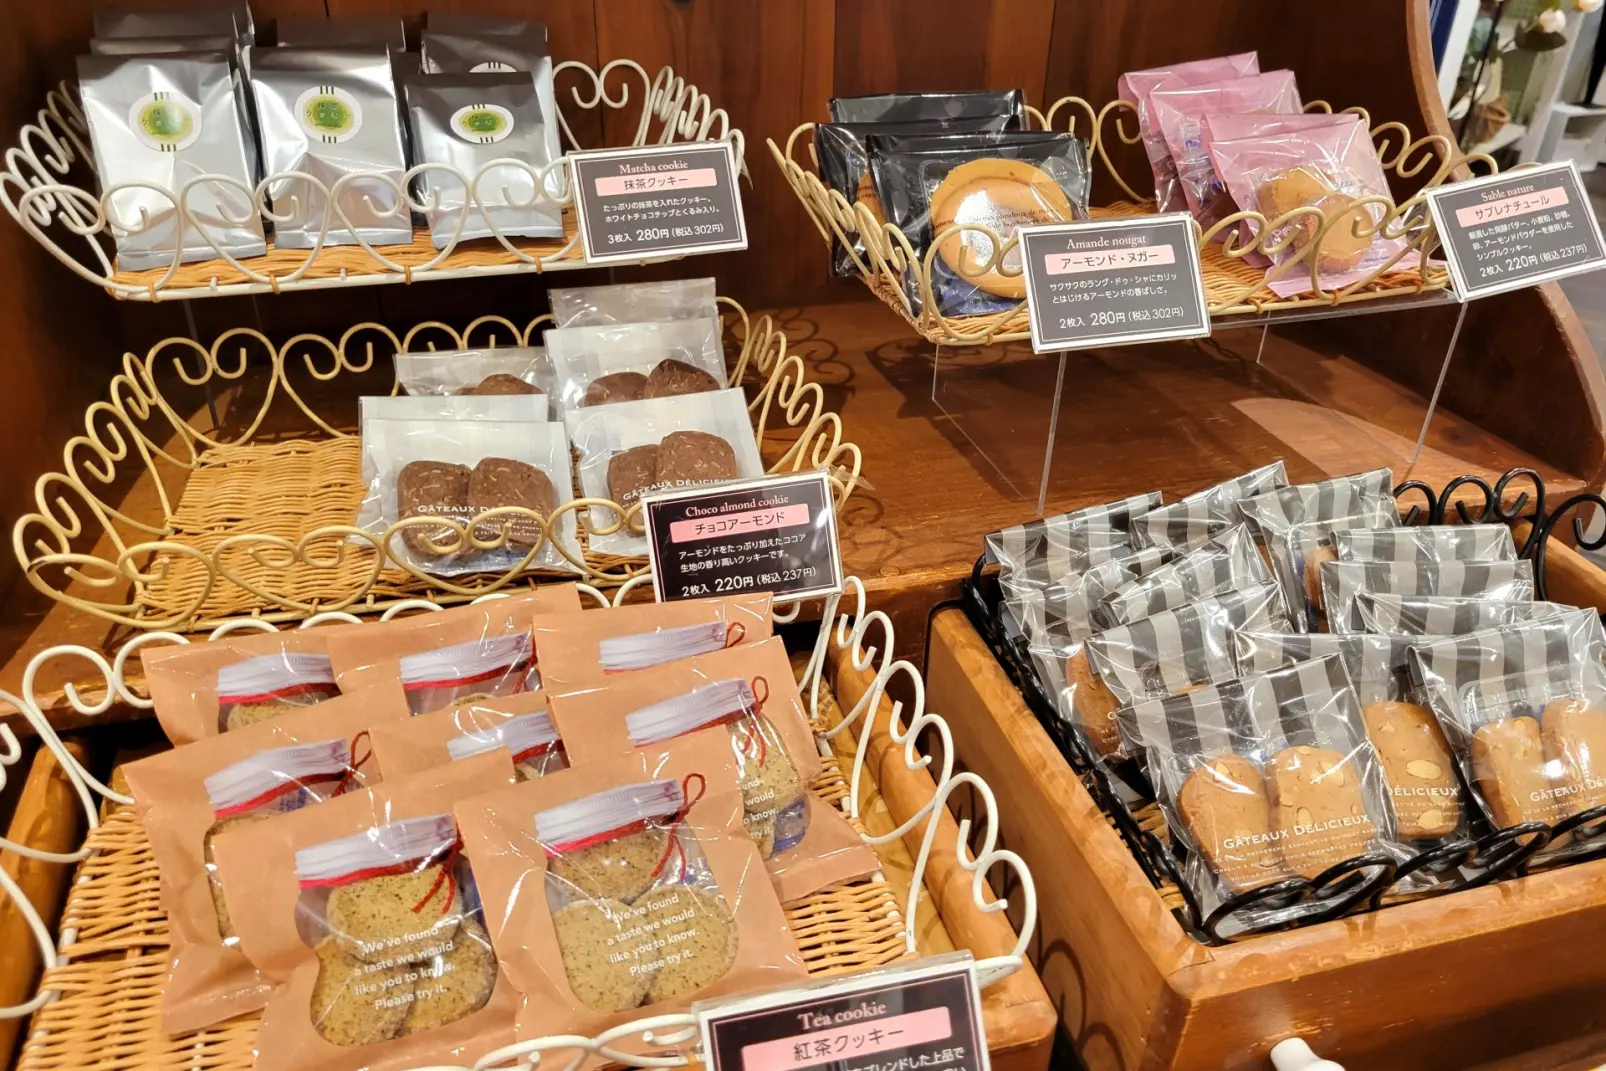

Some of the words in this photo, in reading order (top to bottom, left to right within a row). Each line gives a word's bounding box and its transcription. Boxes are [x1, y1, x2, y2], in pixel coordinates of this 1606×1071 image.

[619, 162, 656, 174] Matcha
[658, 160, 688, 172] cookie
[624, 176, 689, 190] 抹茶クッキー
[1480, 190, 1505, 202] Sable
[1506, 184, 1534, 197] nature
[603, 195, 712, 213] たっぷりの抹茶を入れたクッキー。
[605, 205, 720, 223] ホワイトチョコチップとくるみ入り。
[1474, 195, 1550, 220] サブレナチュール
[608, 234, 632, 244] 3枚入
[1066, 235, 1110, 250] Amande
[1112, 234, 1146, 248] nougat
[1060, 250, 1159, 270] アーモンド・ヌガー
[1052, 286, 1168, 304] とはじけるアーモンドの香ばしさ。
[1060, 316, 1086, 329] 2枚入
[418, 504, 476, 513] GÂTEAUX
[685, 506, 718, 518] Choco
[720, 498, 756, 513] almond
[758, 494, 790, 508] cookie
[694, 512, 786, 536] チョコアーモンド
[678, 534, 807, 560] アーモンドをたっぷり加えたココア
[680, 551, 790, 574] 生地の香り高いクッキーです。
[682, 582, 710, 597] 2枚入
[744, 788, 775, 806] would
[750, 808, 780, 820] know.
[1223, 829, 1290, 849] GÂTEAUX
[1292, 814, 1370, 836] DÉLICIEUX
[647, 892, 680, 912] found
[606, 938, 614, 946] a
[615, 926, 642, 942] taste
[644, 921, 660, 932] we
[662, 907, 696, 926] would
[362, 938, 401, 954] We've
[403, 927, 439, 943] found
[610, 951, 630, 964] like
[632, 943, 653, 960] you
[653, 938, 666, 948] to
[666, 928, 700, 944] know.
[353, 968, 362, 976] a
[364, 959, 394, 974] taste
[396, 954, 414, 964] we
[416, 940, 454, 960] would
[629, 958, 665, 976] Please
[666, 954, 682, 965] try
[682, 948, 694, 960] it.
[355, 982, 377, 996] like
[380, 976, 403, 992] you
[404, 972, 418, 982] to
[374, 992, 414, 1010] Please
[416, 988, 433, 1000] try
[798, 1011, 832, 1030] Tea
[834, 1001, 886, 1024] cookie
[793, 1027, 905, 1062] 紅茶クッキー
